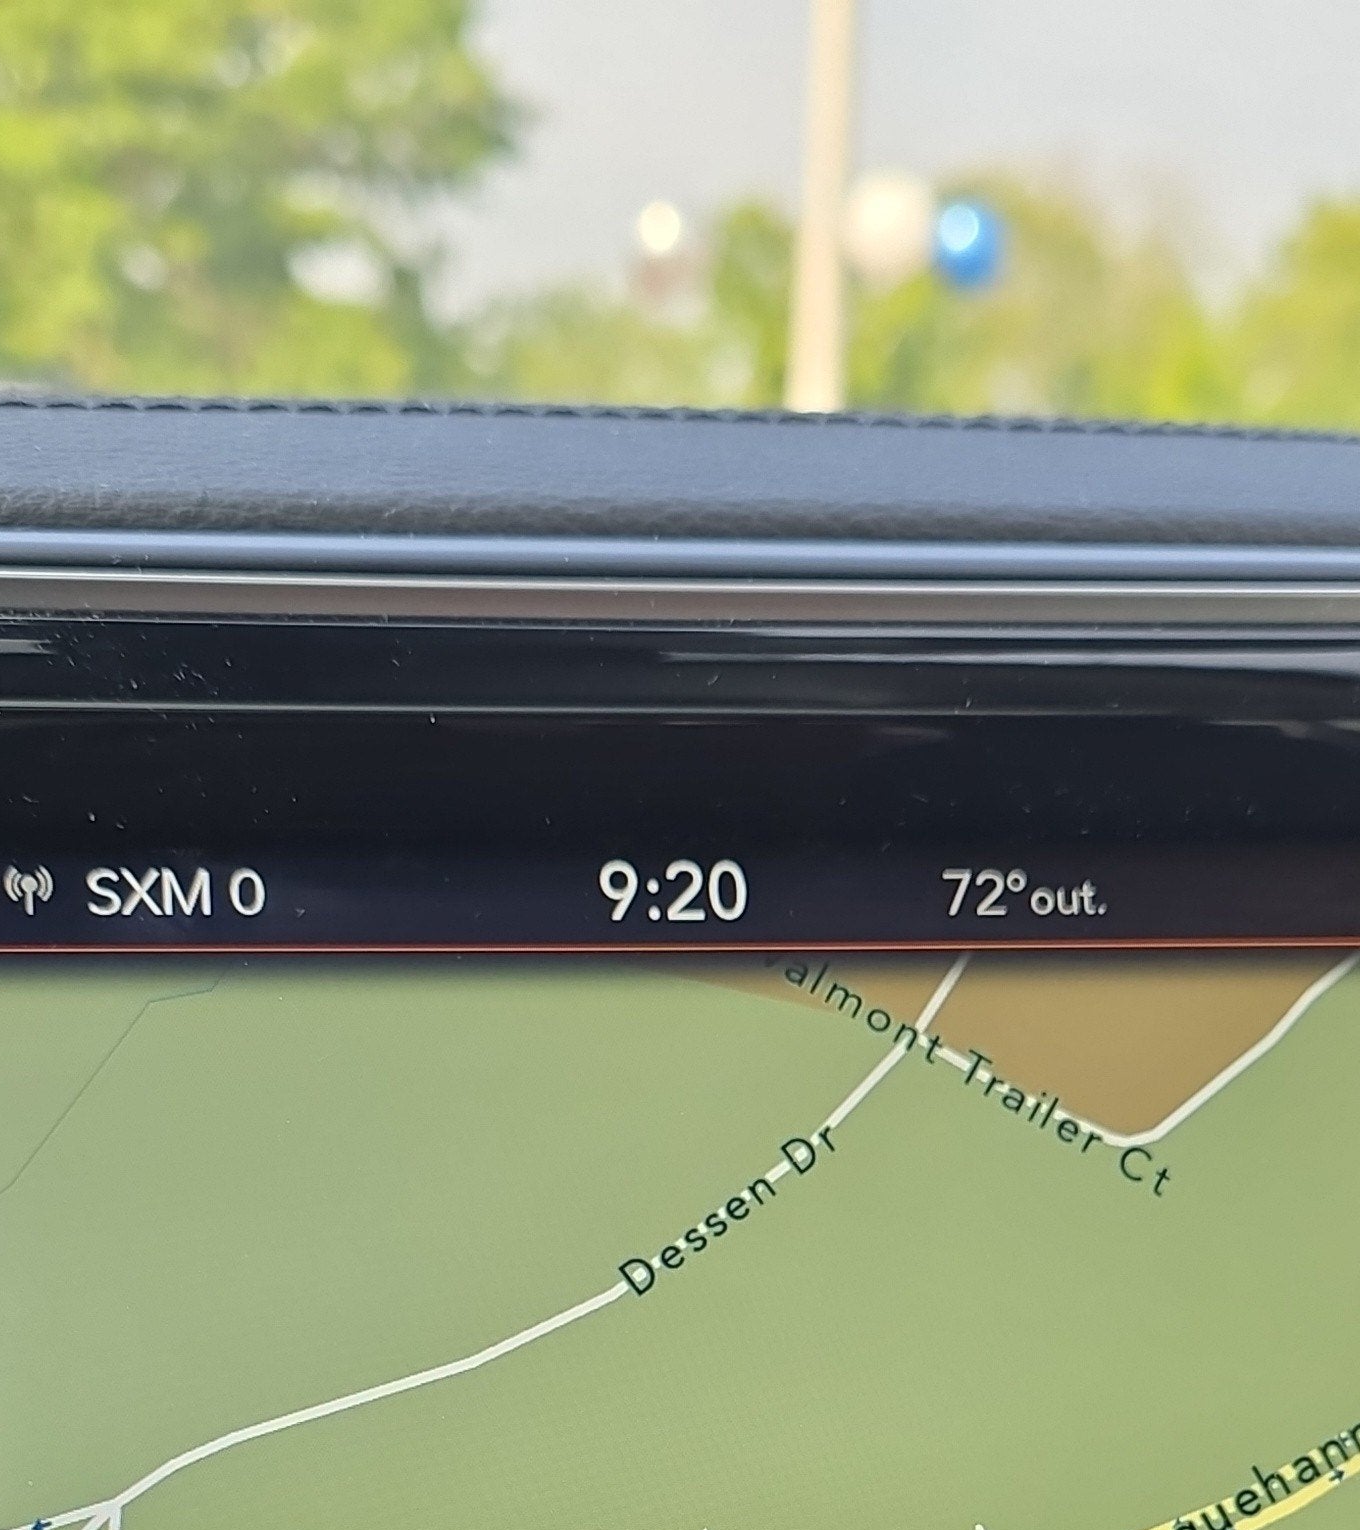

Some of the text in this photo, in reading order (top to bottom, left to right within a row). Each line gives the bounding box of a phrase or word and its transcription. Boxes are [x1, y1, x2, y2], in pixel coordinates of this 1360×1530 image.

[86, 867, 266, 916] SXM 0
[599, 859, 747, 921] 9:20
[764, 956, 1171, 1196] almont Trailer Ct
[618, 1125, 836, 1296] Dessen Dr
